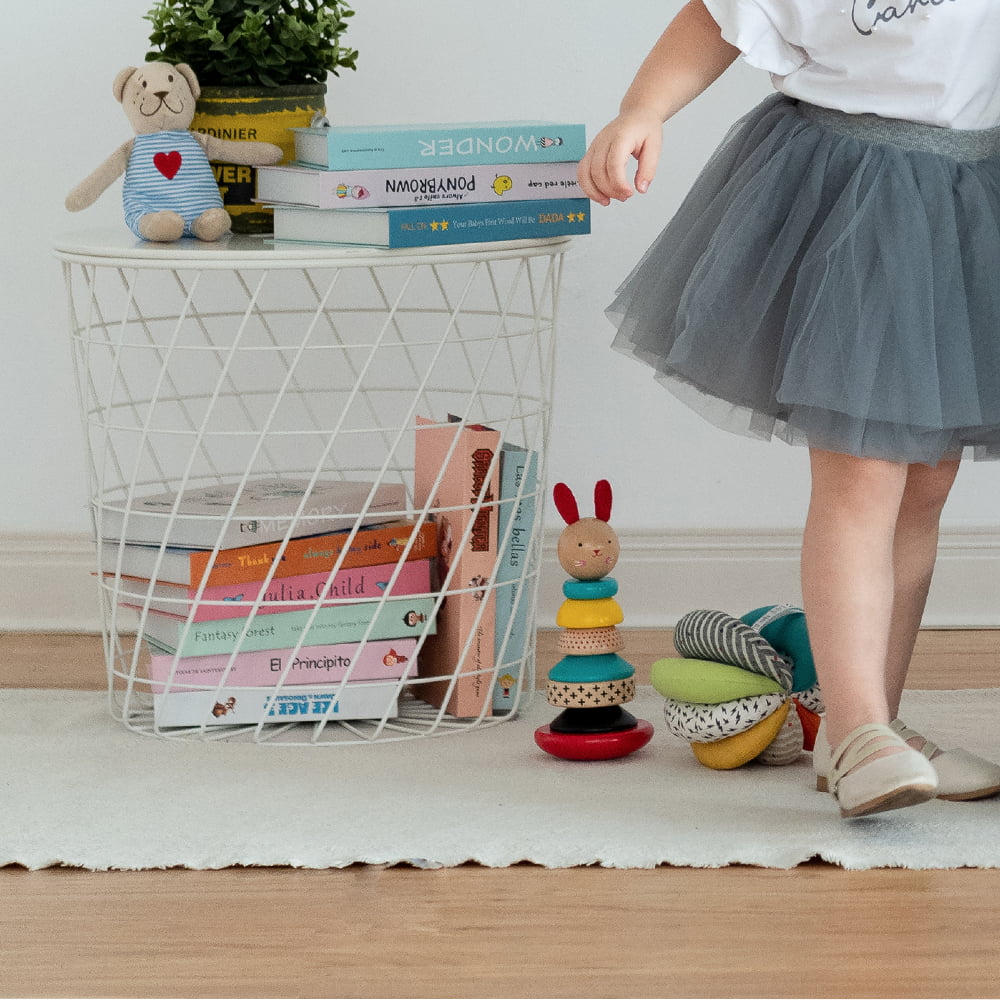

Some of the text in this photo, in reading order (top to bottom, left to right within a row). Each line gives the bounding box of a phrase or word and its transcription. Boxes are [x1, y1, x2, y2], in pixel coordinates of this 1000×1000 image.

[417, 136, 538, 156] WONDER
[386, 174, 476, 193] PONYBROWN
[528, 180, 579, 189] ittle red cap
[538, 213, 564, 224] DADA
[510, 527, 526, 567] bellas
[239, 553, 270, 567] Thank
[195, 629, 238, 642] Fantasy
[270, 655, 351, 672] El Principito
[278, 701, 310, 716] AGE
